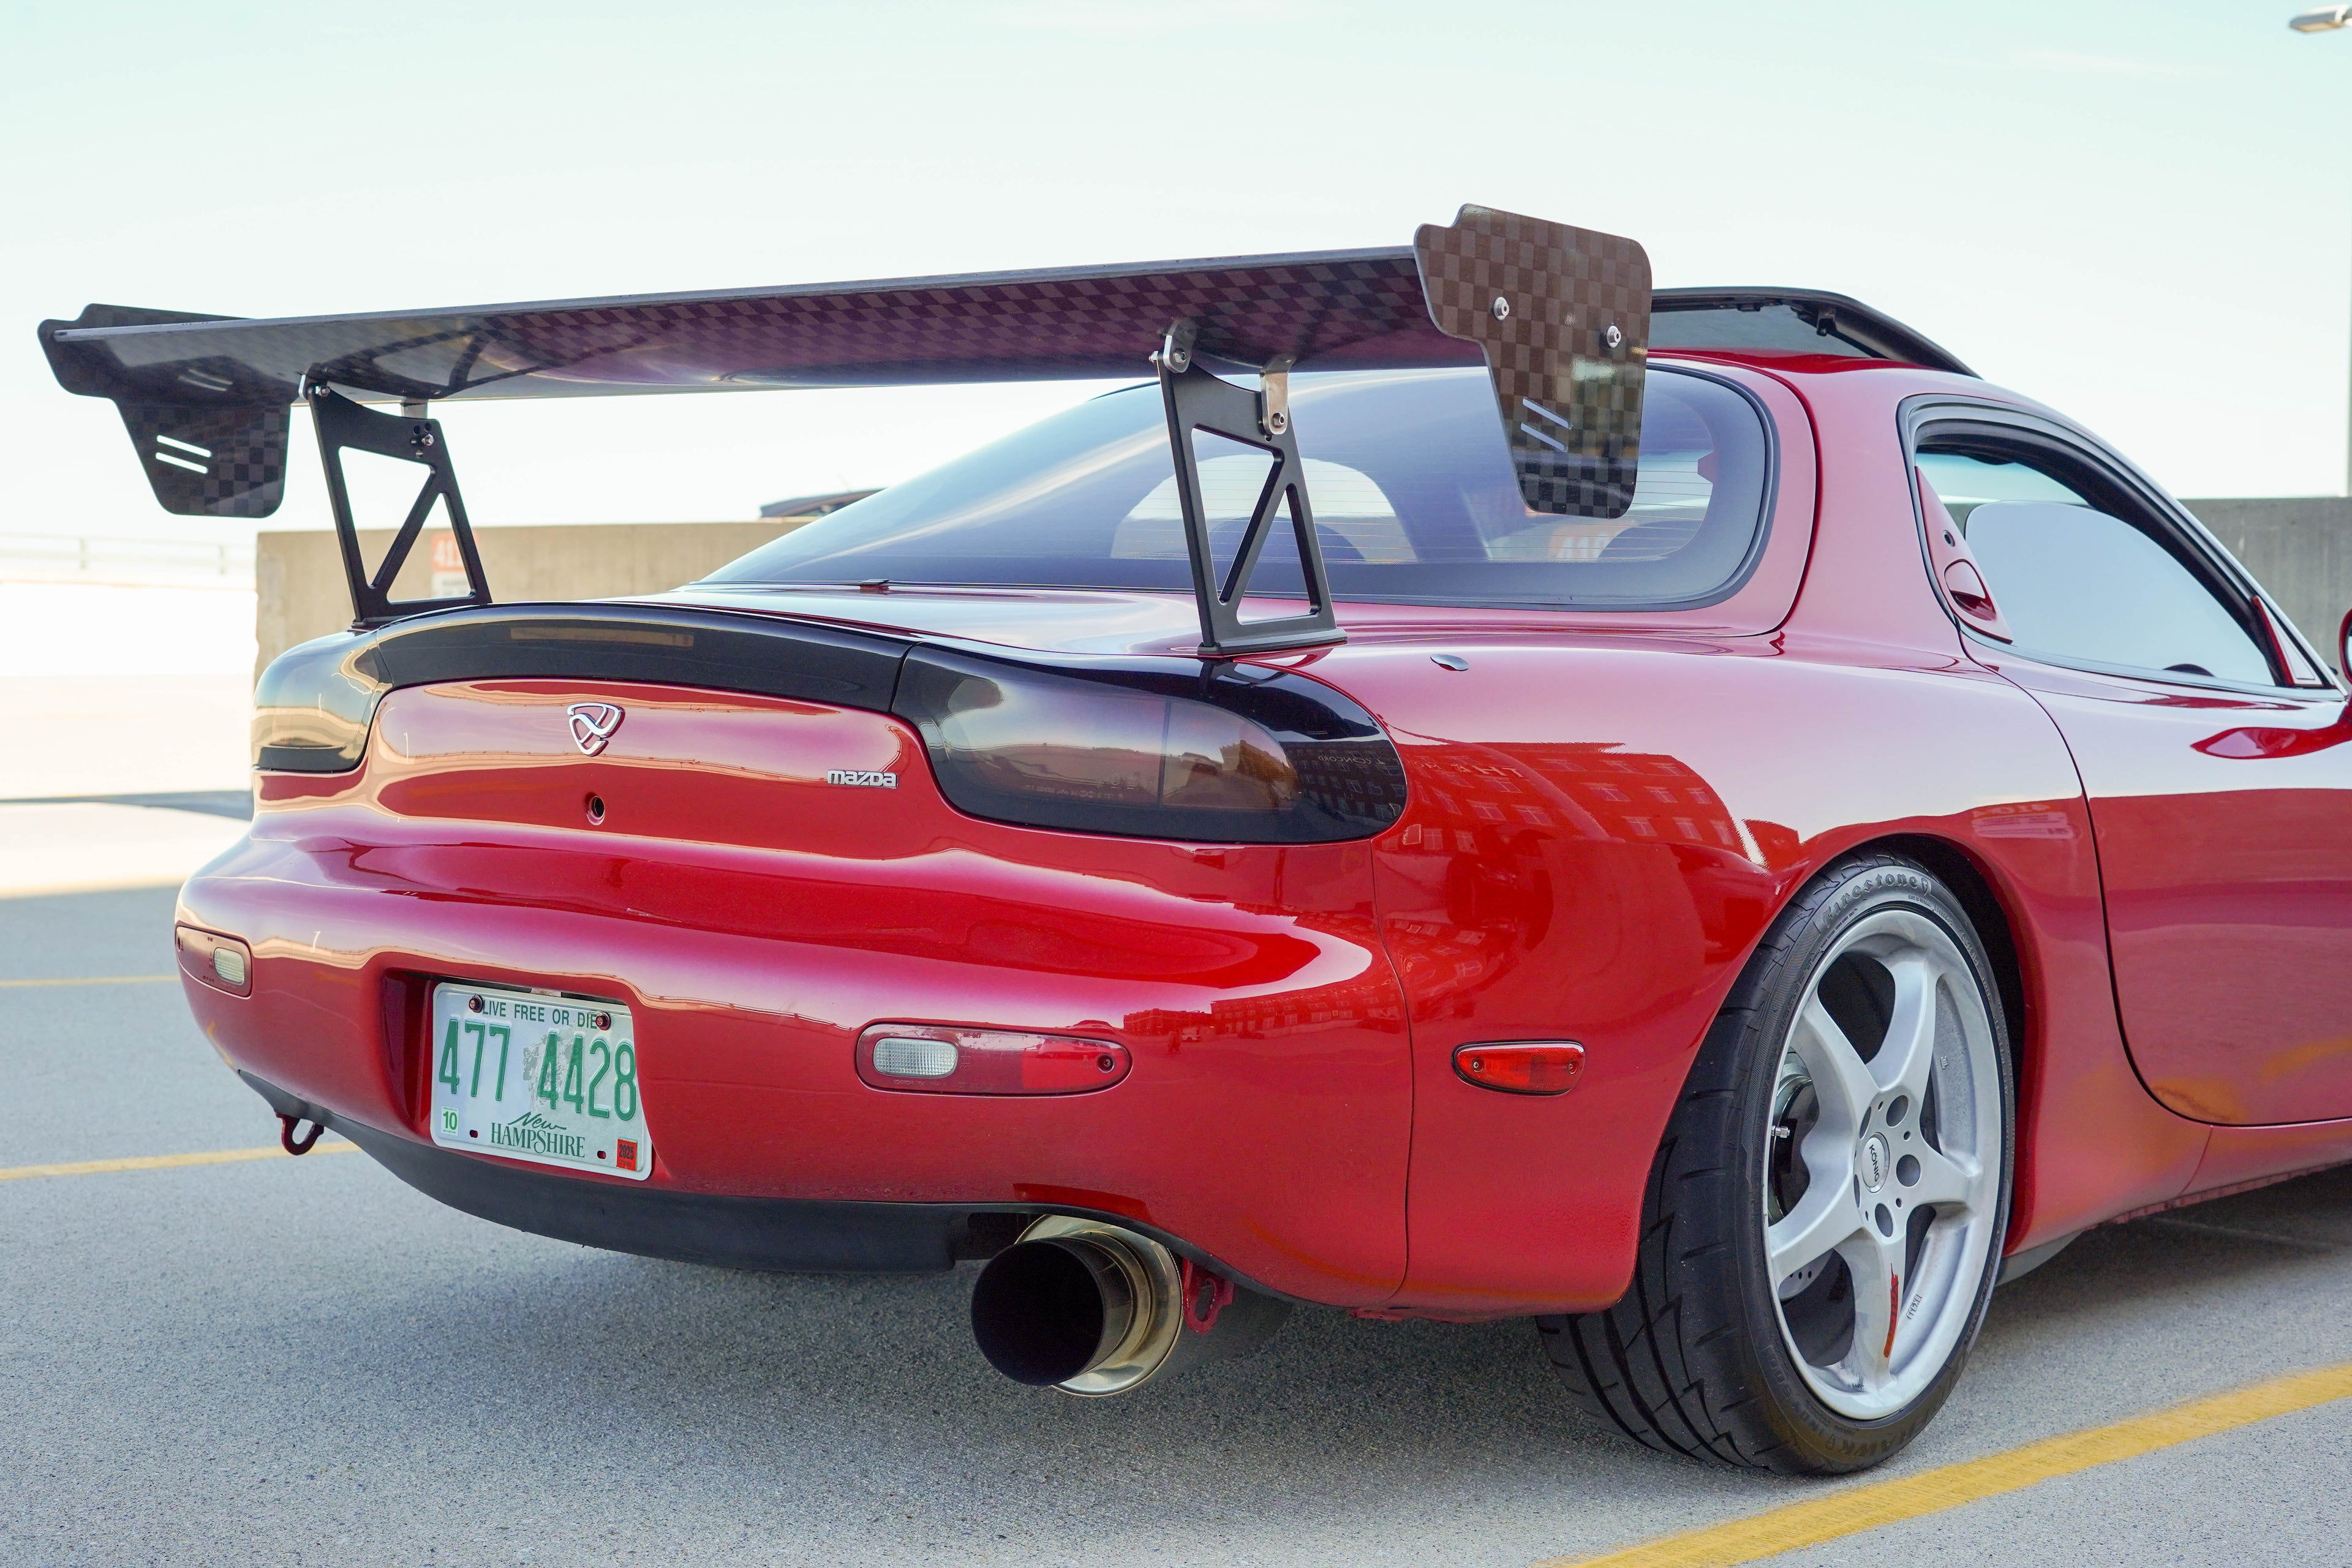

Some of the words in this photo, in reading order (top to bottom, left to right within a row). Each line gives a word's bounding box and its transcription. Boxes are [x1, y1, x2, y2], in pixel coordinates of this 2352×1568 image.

[827, 769, 897, 788] mazda
[1822, 873, 1918, 929] Firestone
[483, 999, 507, 1017] LIVE
[514, 1003, 545, 1022] FREE
[552, 1008, 570, 1026] OR
[577, 1011, 598, 1030] DIE
[439, 1019, 510, 1101] 477
[537, 1031, 636, 1121] 4428
[443, 1110, 458, 1131] 10
[507, 1111, 567, 1131] New
[490, 1121, 586, 1158] HAMPSHIRE
